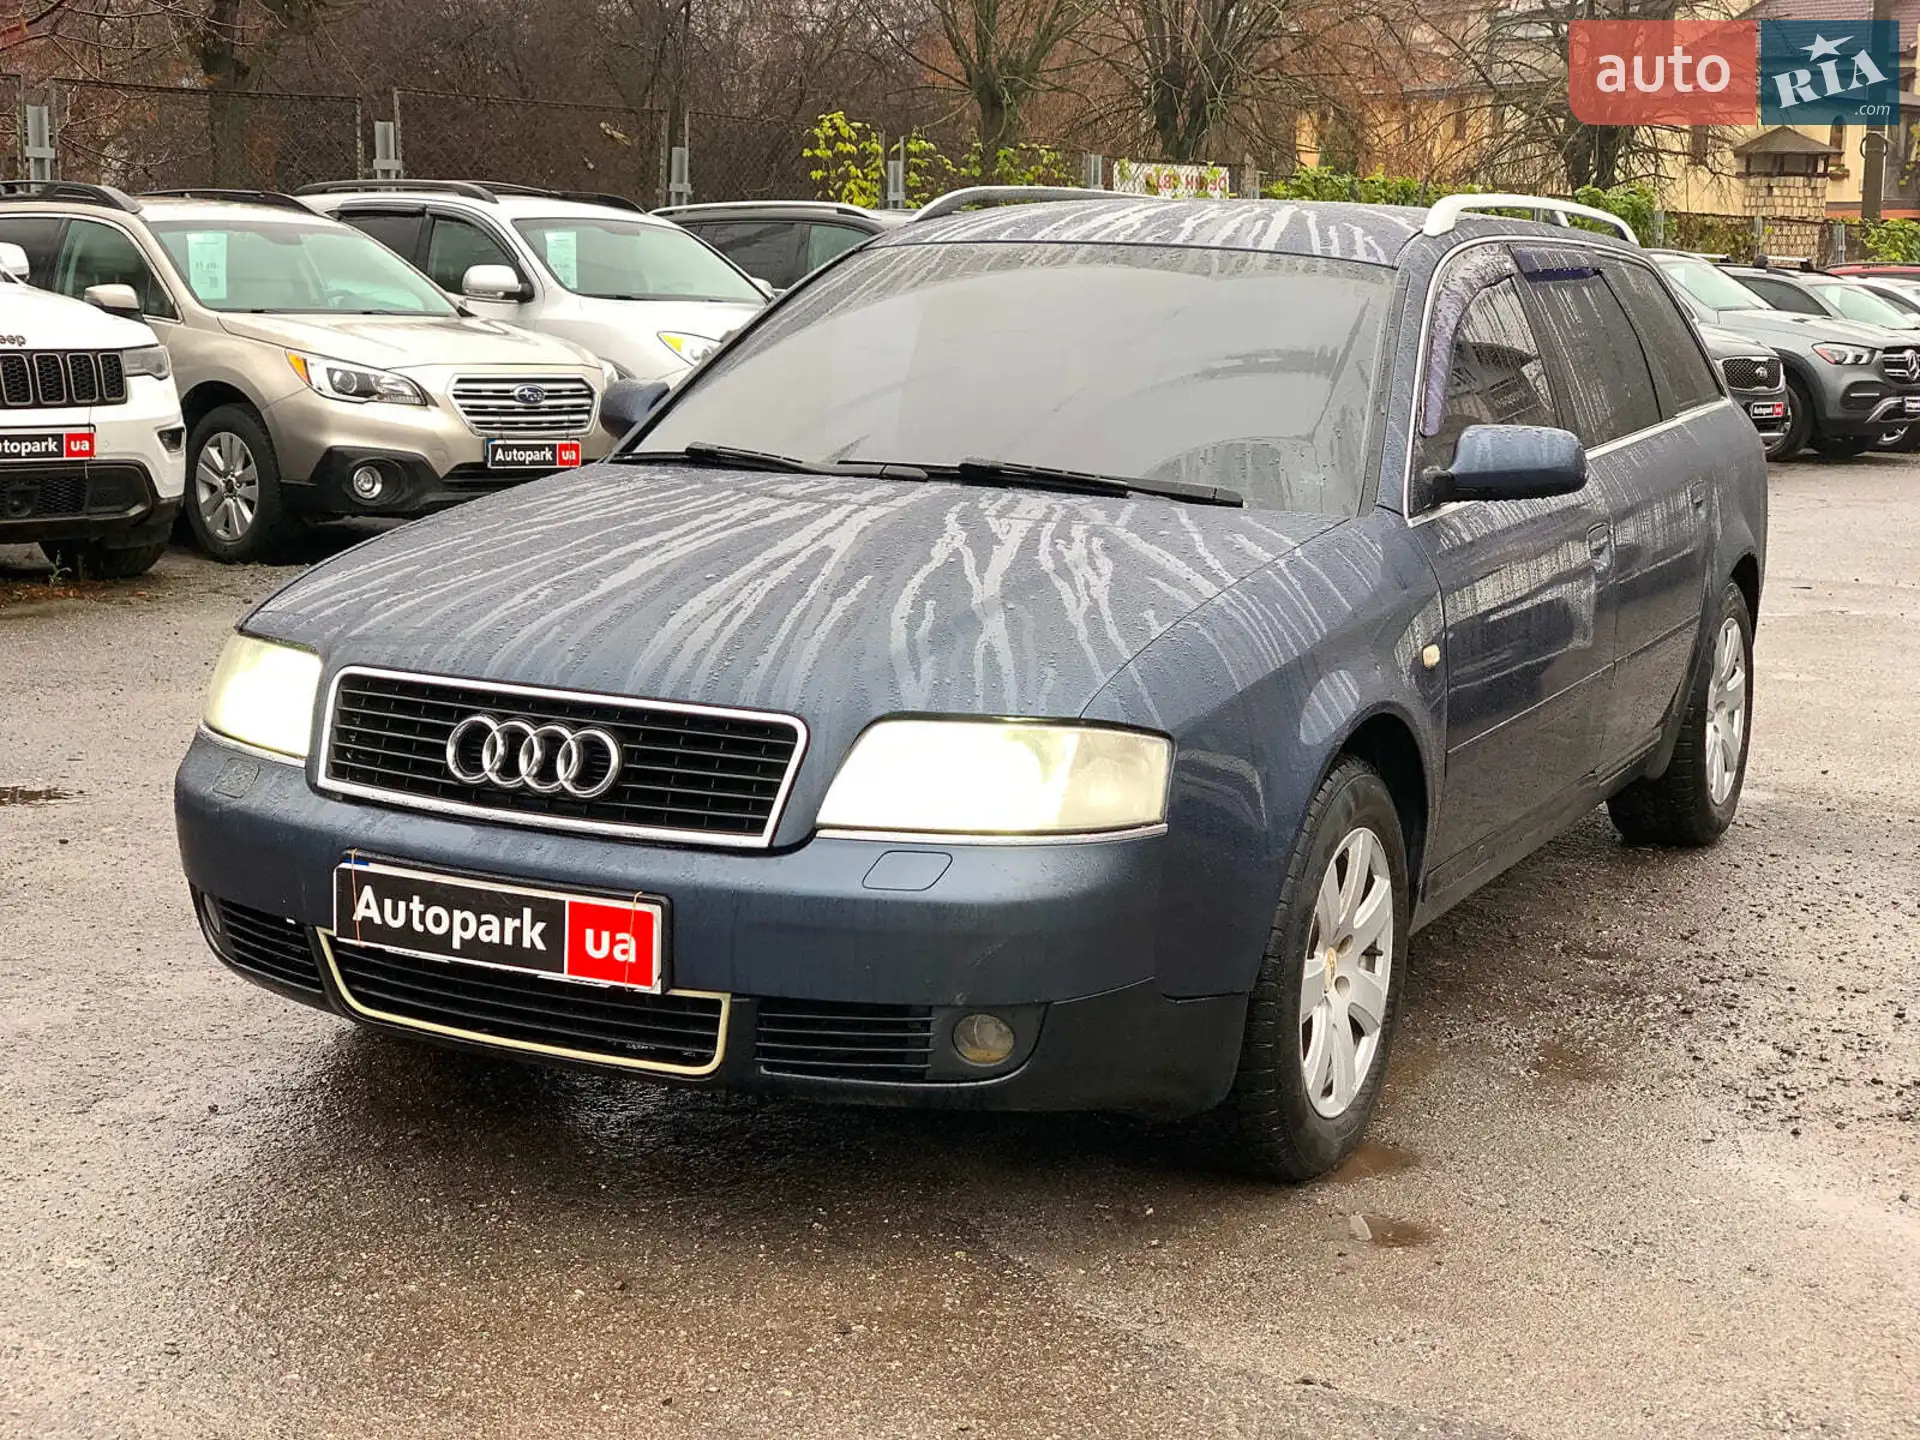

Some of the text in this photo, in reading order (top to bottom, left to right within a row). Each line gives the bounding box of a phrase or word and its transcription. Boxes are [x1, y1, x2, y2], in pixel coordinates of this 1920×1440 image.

[0, 436, 90, 457] topark ua
[495, 446, 576, 465] Autopark ua
[352, 884, 637, 963] Autopark ua
